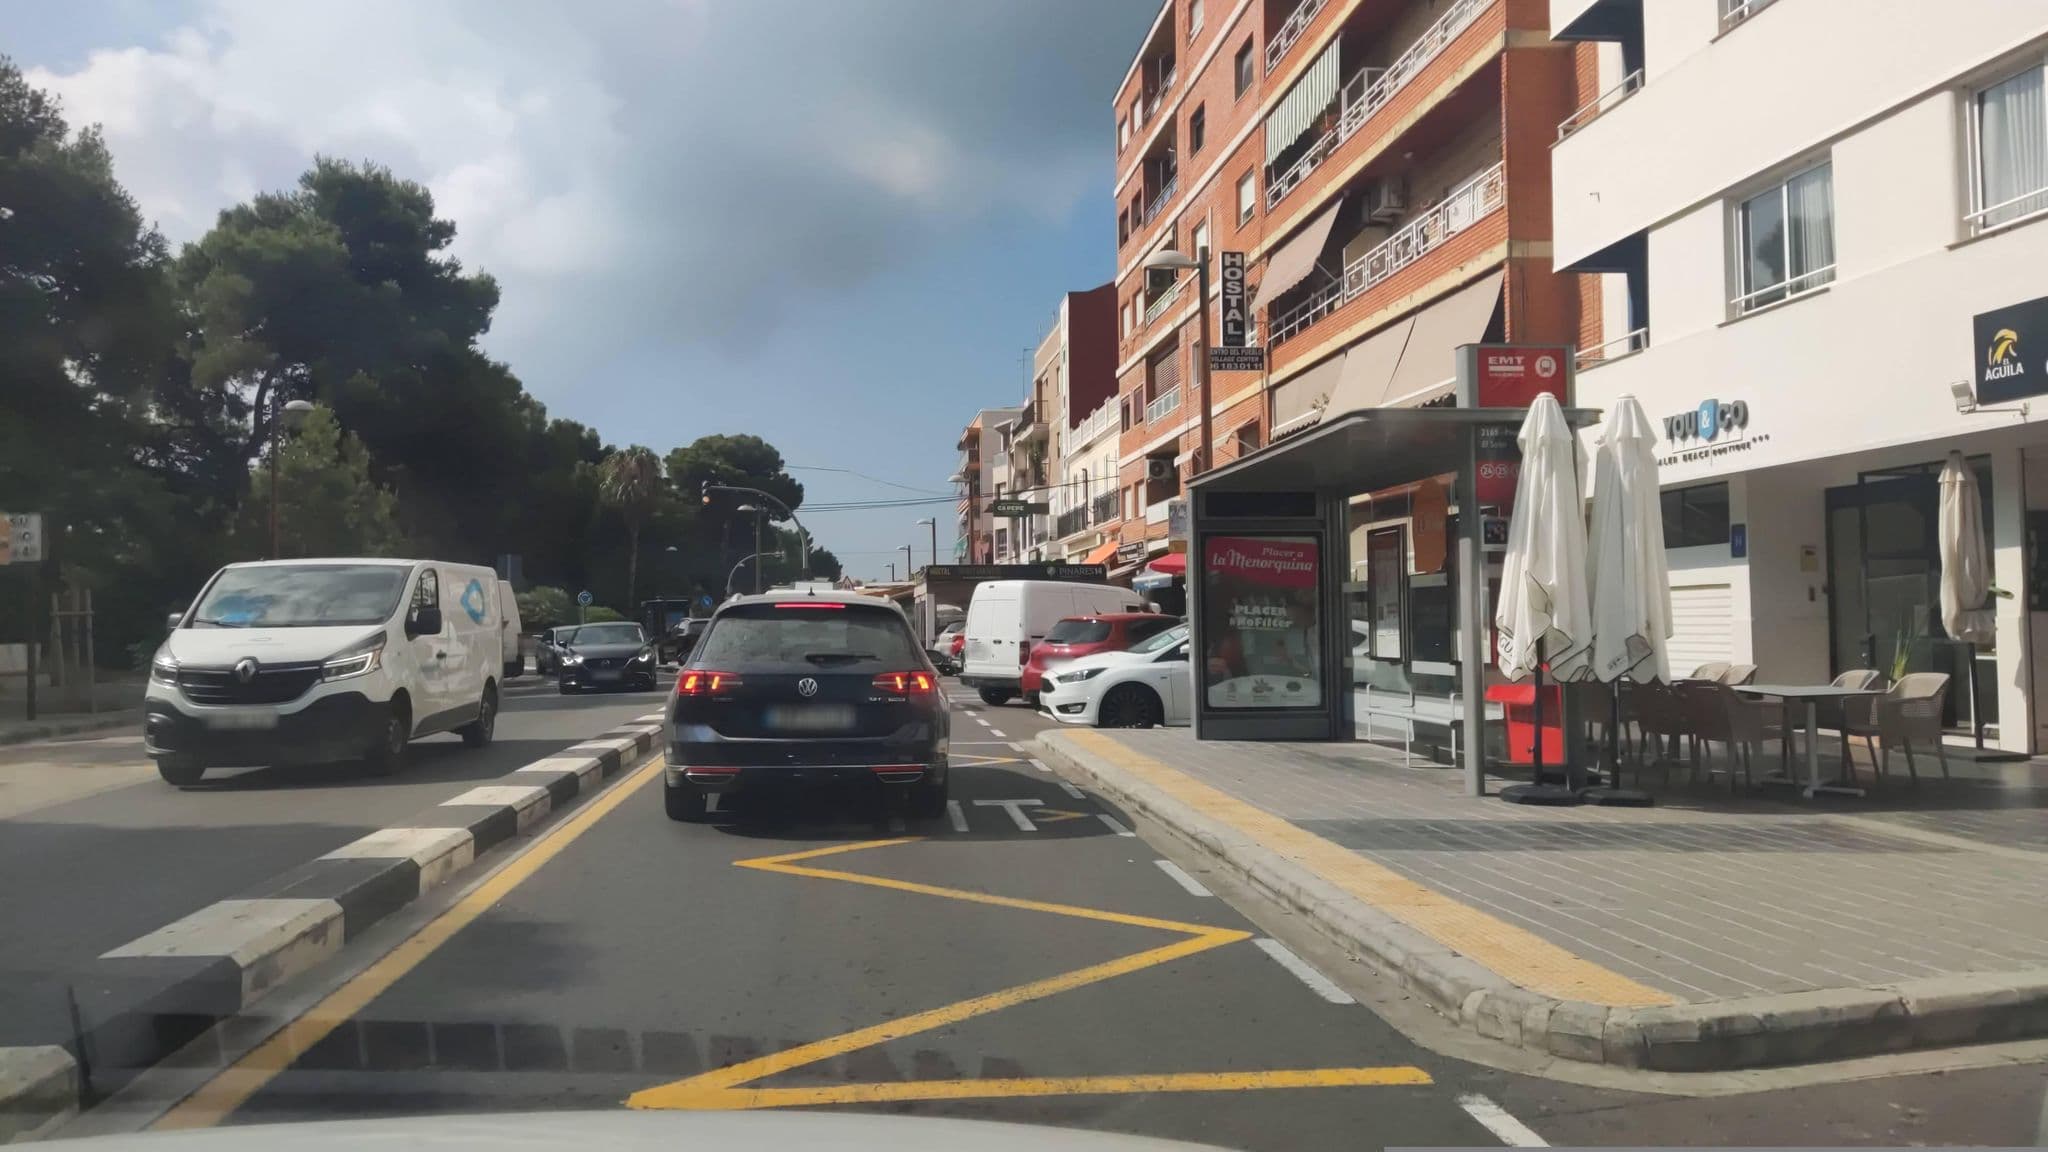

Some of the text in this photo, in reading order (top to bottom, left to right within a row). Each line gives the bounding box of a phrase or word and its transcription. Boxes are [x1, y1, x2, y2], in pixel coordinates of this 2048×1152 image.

[1224, 253, 1243, 335] HOSTAL
[1488, 356, 1525, 365] EMT
[1657, 456, 1678, 466] ALER
[1712, 442, 1752, 457] BOUTIQUE
[1262, 547, 1304, 558] Placer a
[1227, 549, 1313, 574] Menorquina
[1235, 605, 1287, 616] PLACER
